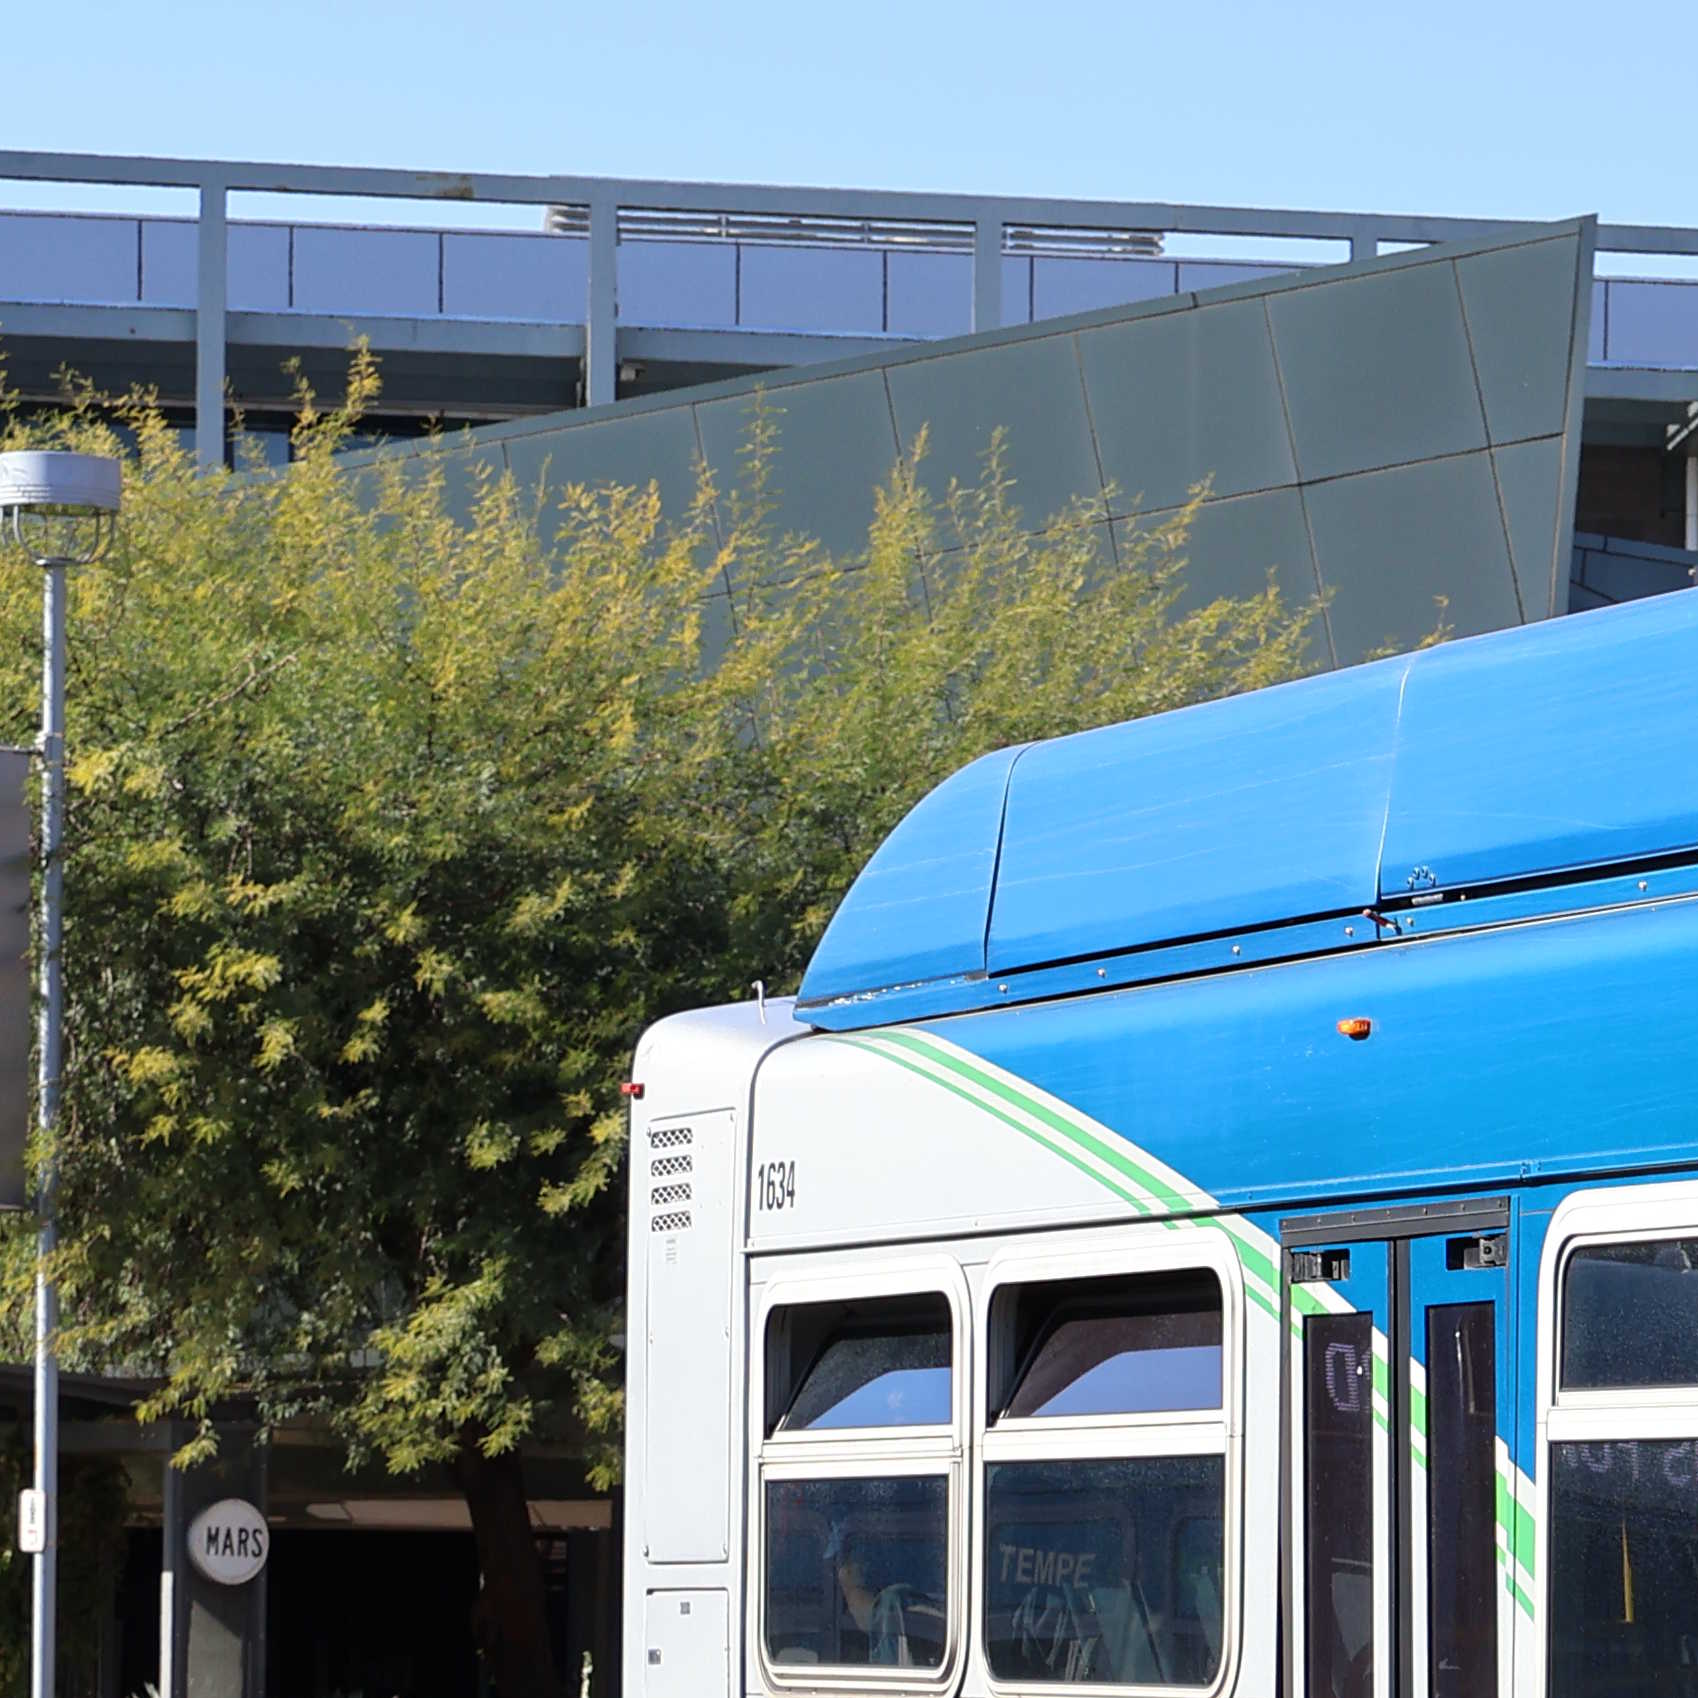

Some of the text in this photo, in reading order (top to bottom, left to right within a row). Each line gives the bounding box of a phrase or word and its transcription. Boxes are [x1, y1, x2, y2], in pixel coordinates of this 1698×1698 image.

[758, 1160, 796, 1211] 1634
[206, 1525, 263, 1558] MARS
[999, 1543, 1097, 1589] TEMPE
